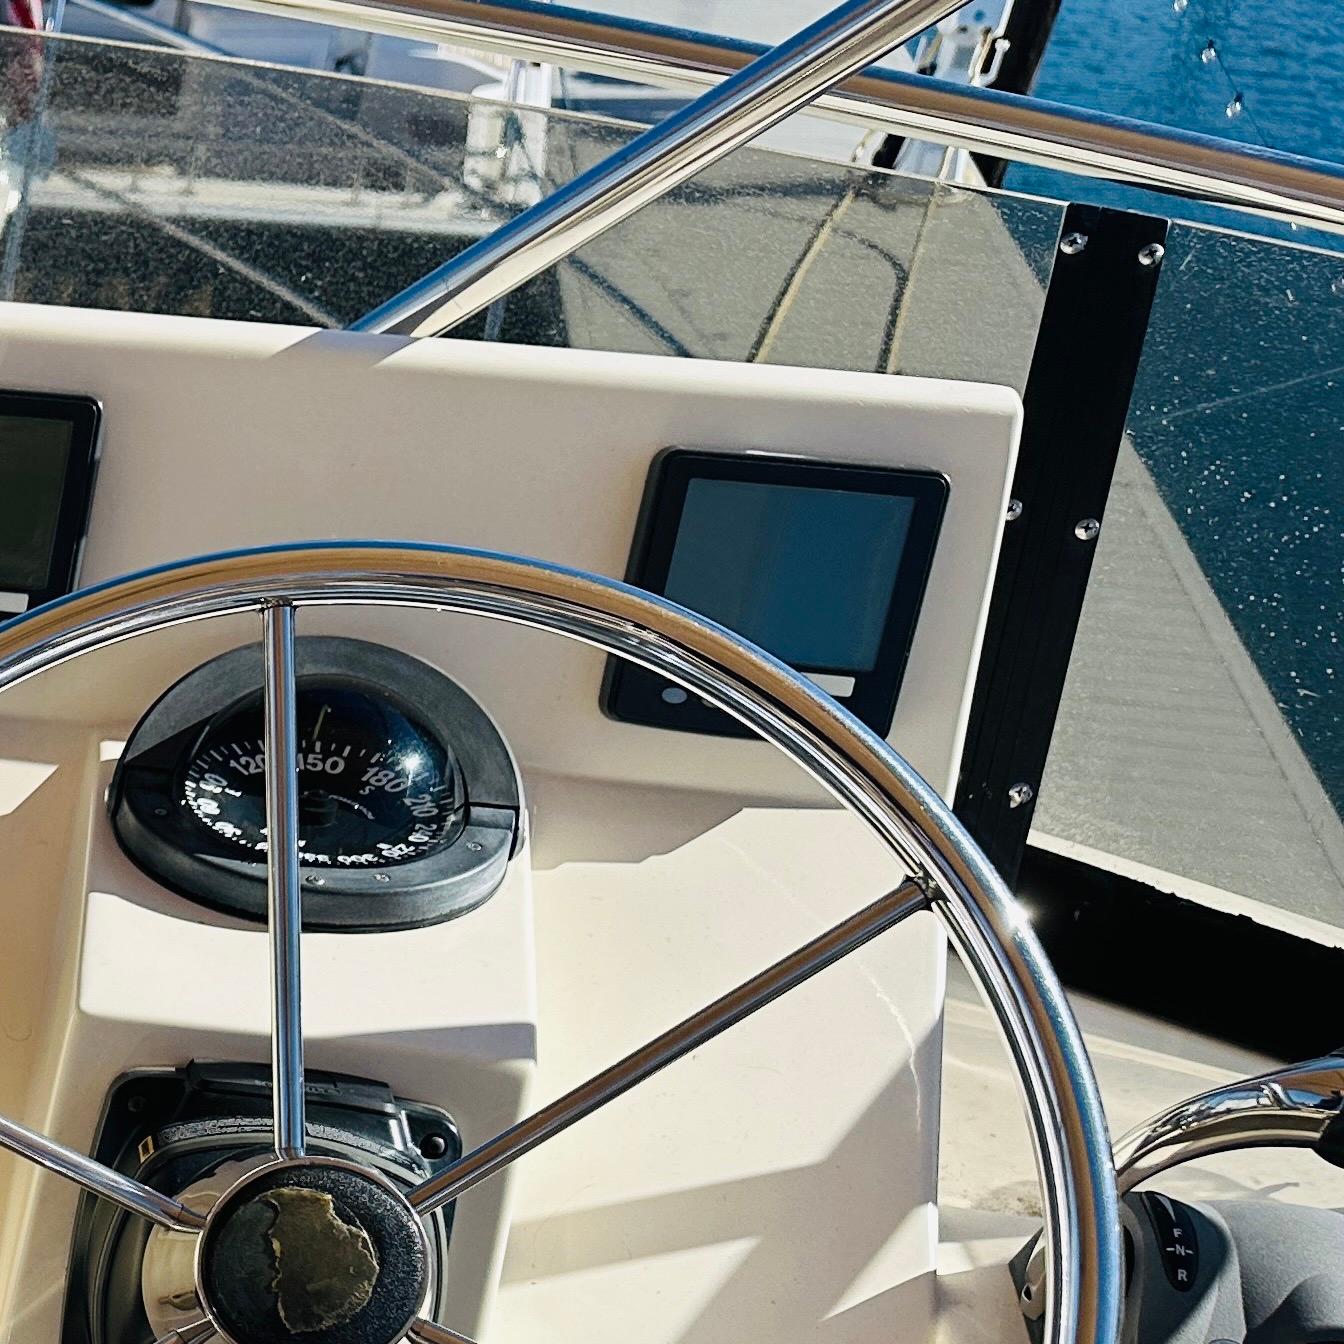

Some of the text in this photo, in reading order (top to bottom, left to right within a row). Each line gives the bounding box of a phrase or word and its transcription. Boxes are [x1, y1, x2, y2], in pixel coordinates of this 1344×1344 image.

[297, 753, 346, 775] 150
[362, 766, 409, 793] 180
[403, 794, 439, 817] 210
[1173, 1228, 1183, 1238] F
[1177, 1269, 1188, 1282] R
